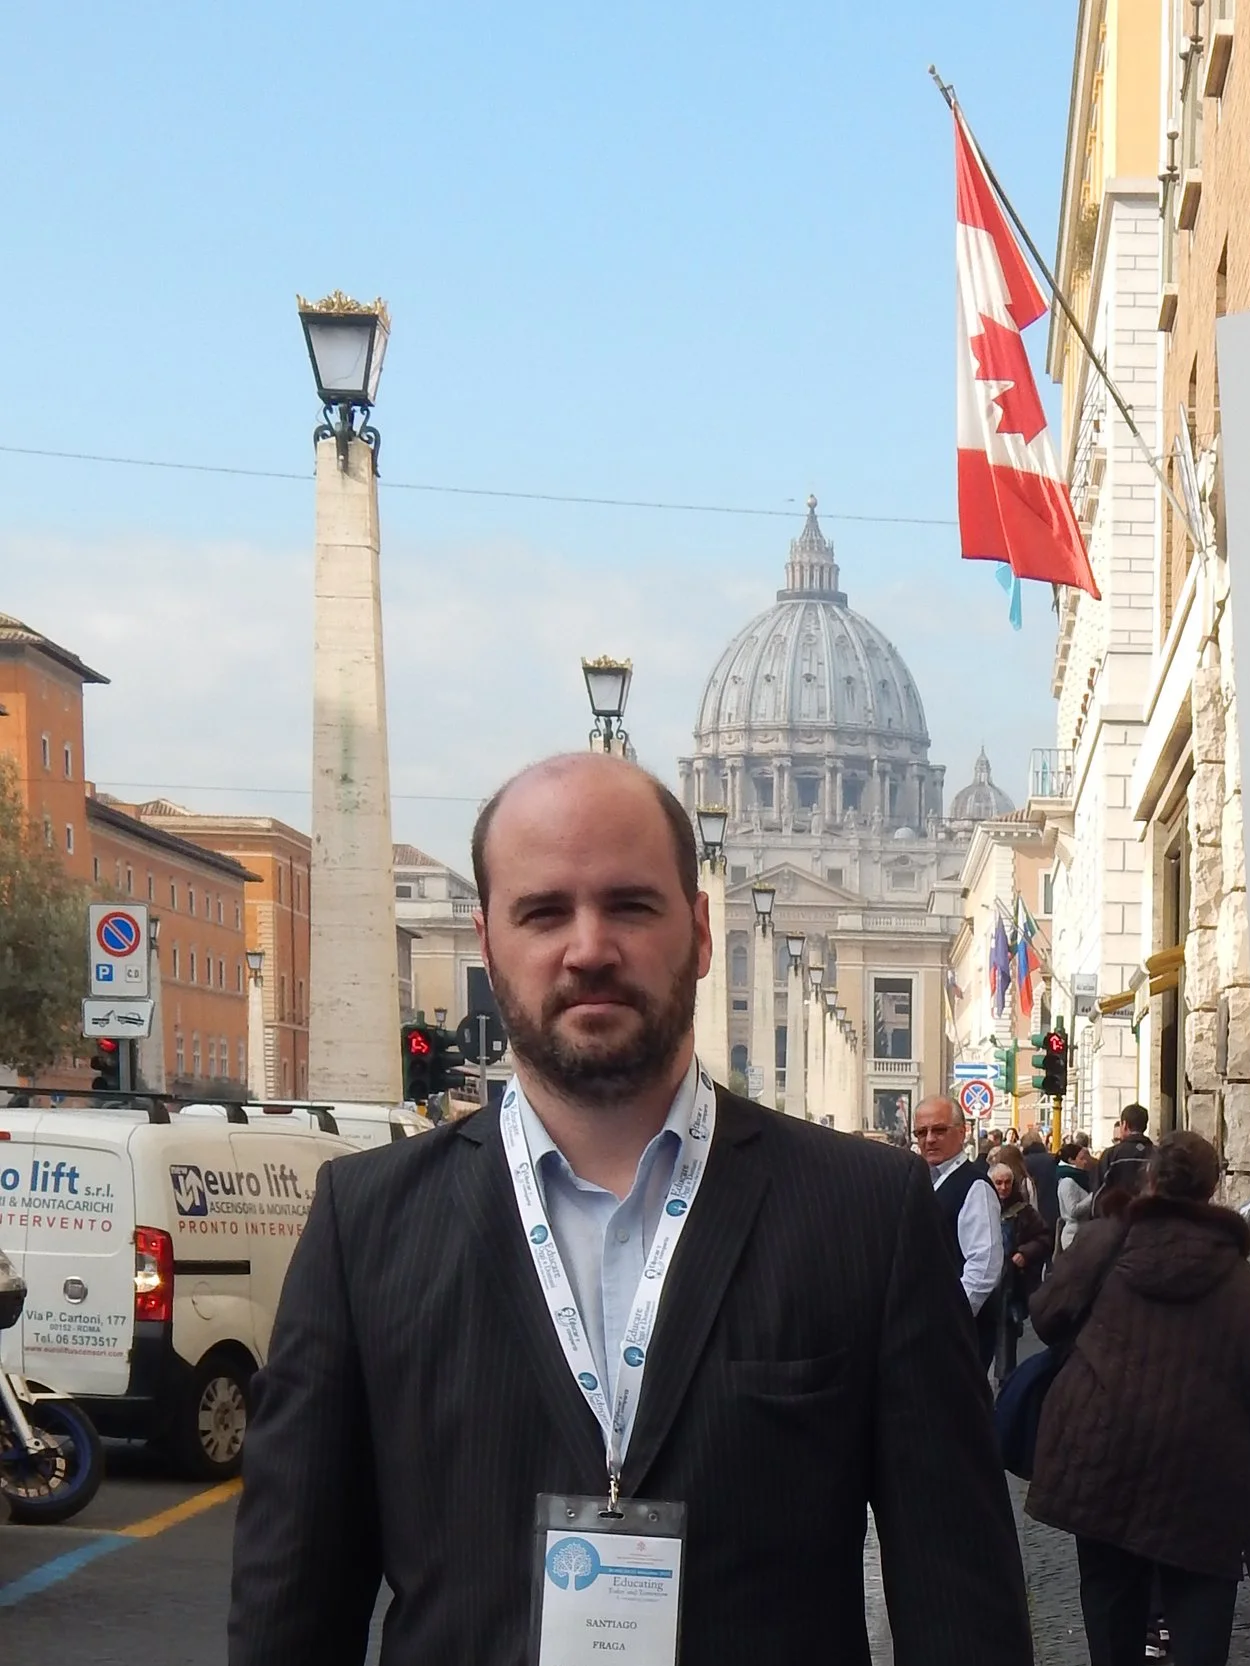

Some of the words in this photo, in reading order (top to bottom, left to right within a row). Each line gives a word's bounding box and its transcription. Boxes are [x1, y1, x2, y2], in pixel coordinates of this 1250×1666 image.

[30, 1160, 79, 1194] lift
[84, 1183, 114, 1198] s.r.l.
[204, 1169, 261, 1197] euro
[263, 1163, 302, 1199] lift
[9, 1196, 17, 1207] &
[21, 1197, 113, 1213] MONTACARICHI
[210, 1202, 257, 1215] ASCENSORI
[178, 1220, 238, 1235] PRONTO
[545, 1242, 560, 1279] Educare
[26, 1310, 43, 1321] Via
[58, 1312, 103, 1326] Cartoni,
[107, 1315, 126, 1326] 177
[626, 1307, 643, 1343] Educare
[33, 1332, 53, 1344] Tel.
[55, 1334, 69, 1345] 06
[71, 1335, 118, 1348] 5373517
[613, 1577, 664, 1592] Educating
[586, 1619, 637, 1629] SANTIAGO
[593, 1641, 625, 1651] FRAGA
